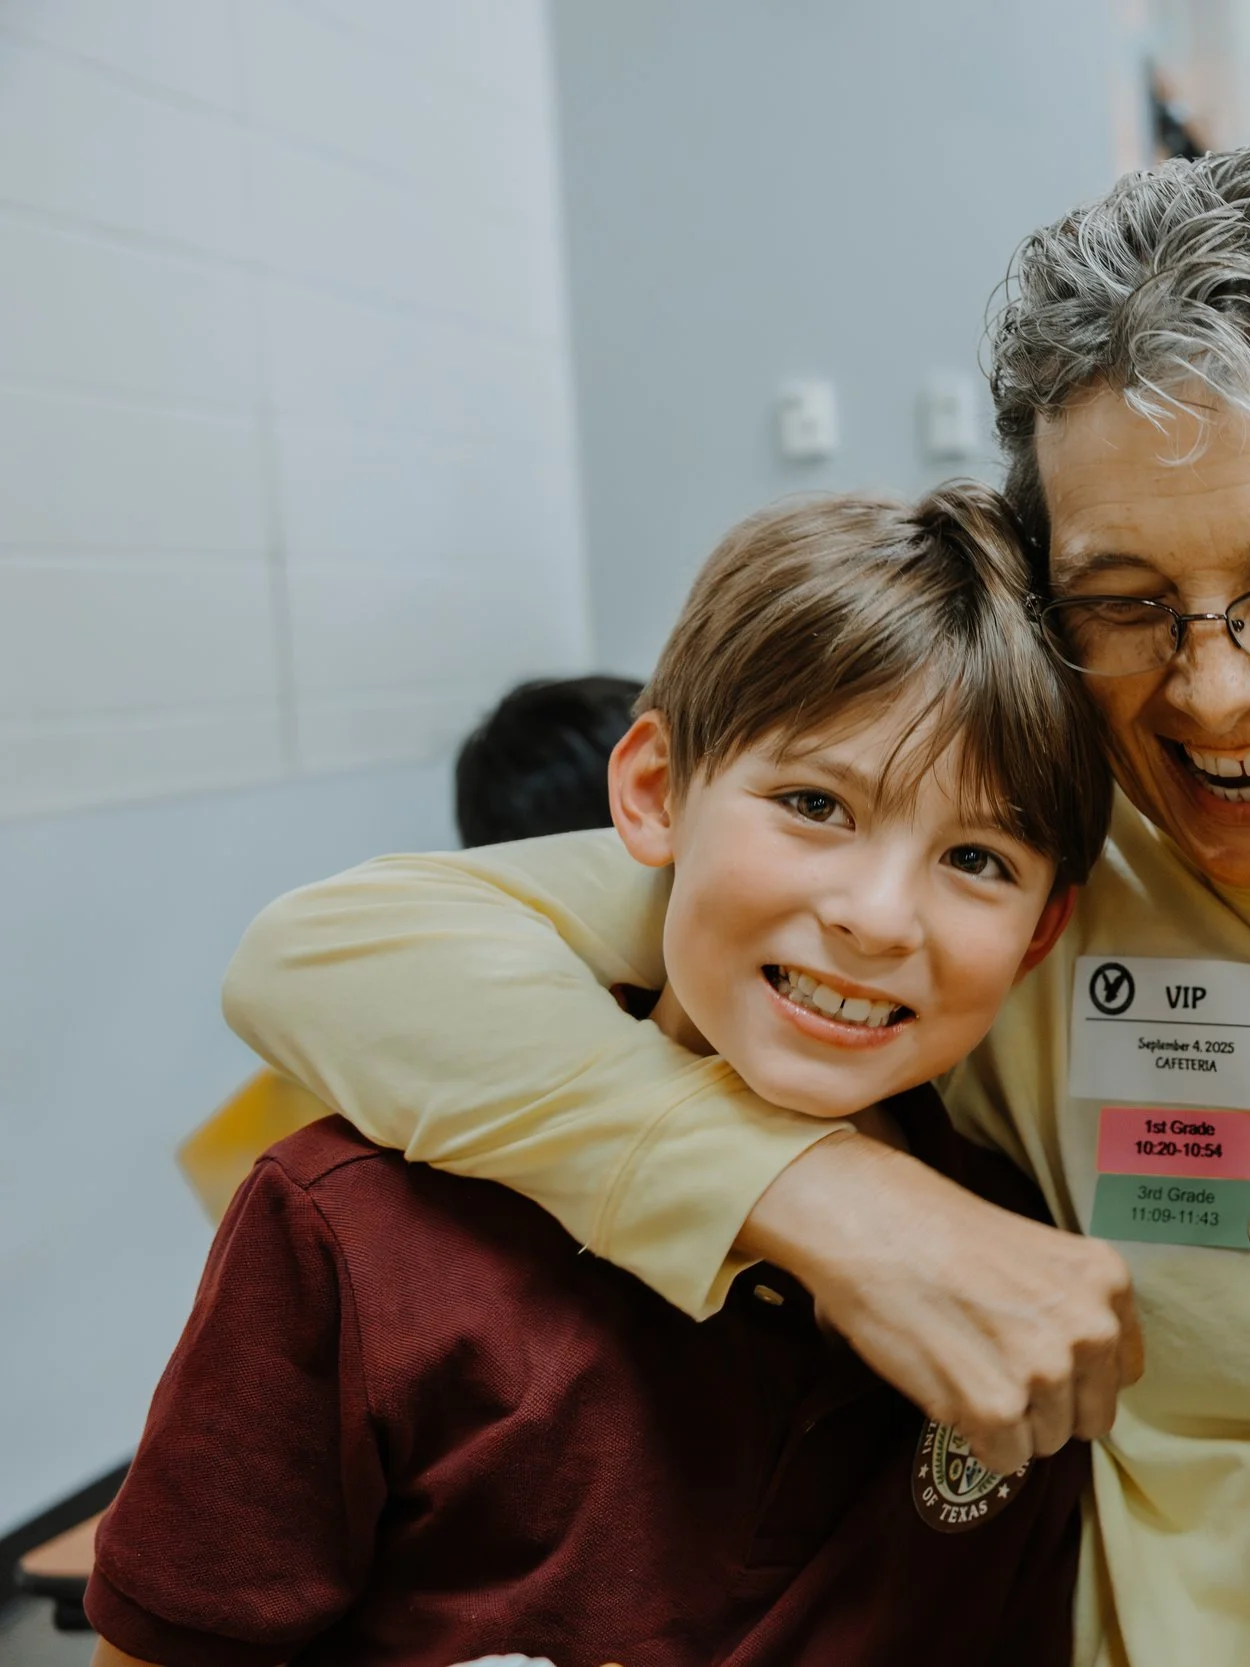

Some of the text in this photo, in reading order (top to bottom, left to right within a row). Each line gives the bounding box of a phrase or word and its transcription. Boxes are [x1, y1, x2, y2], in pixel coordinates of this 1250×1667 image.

[1165, 985, 1207, 1009] VIP
[1138, 1037, 1190, 1052] September
[1205, 1041, 1234, 1054] 2025
[1156, 1057, 1217, 1072] CAFETERIA
[1145, 1120, 1215, 1136] 1st Grade
[1135, 1142, 1223, 1158] 10:20-10:54
[1138, 1186, 1215, 1204] 3rd Grade
[1132, 1208, 1219, 1226] 11:09-11:43
[922, 1486, 988, 1523] OF TEXAS
